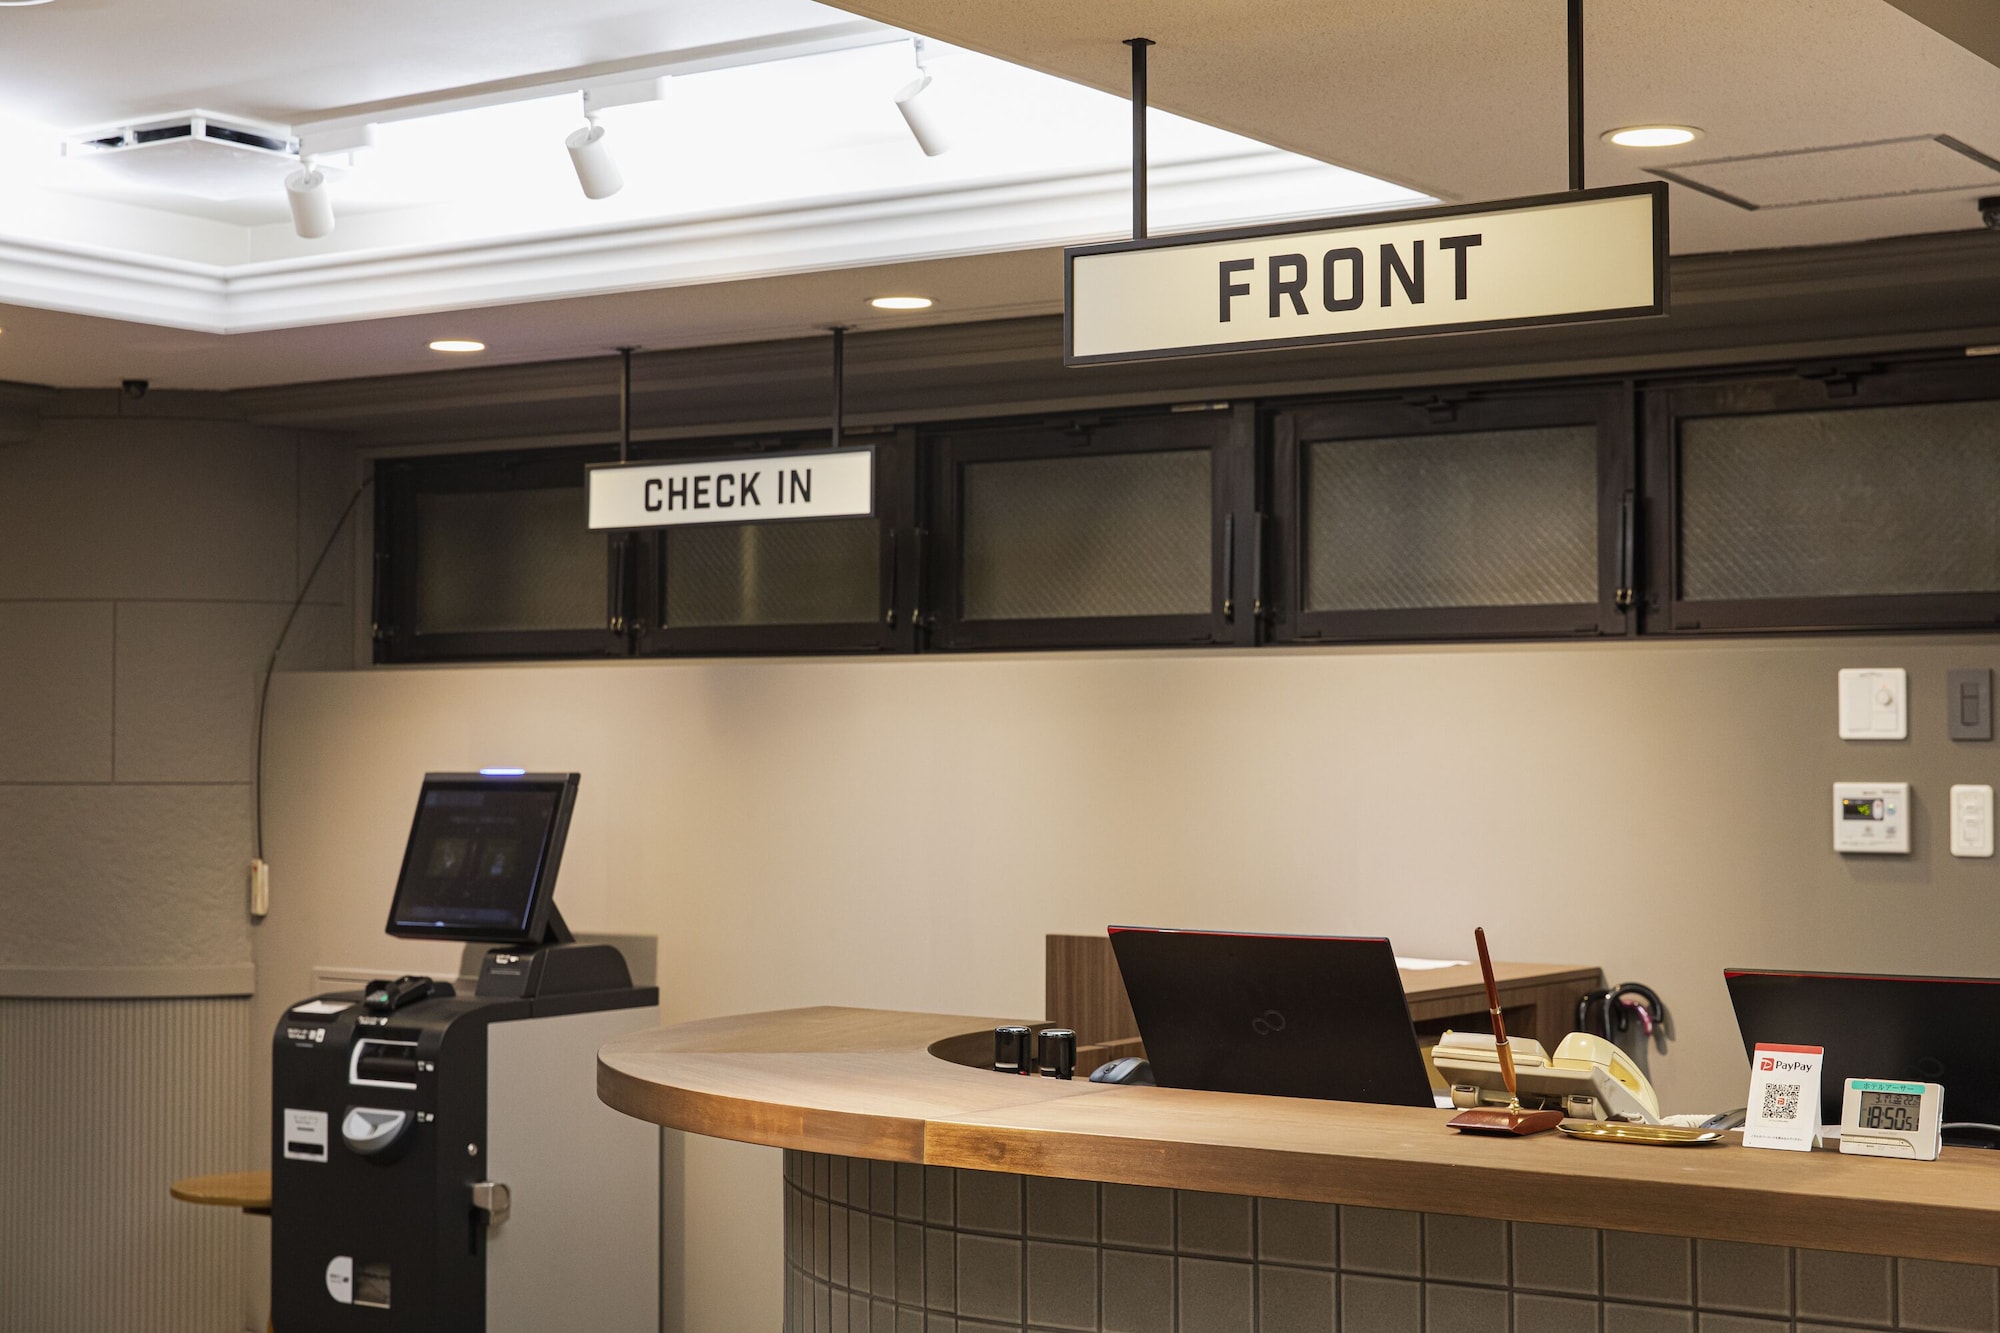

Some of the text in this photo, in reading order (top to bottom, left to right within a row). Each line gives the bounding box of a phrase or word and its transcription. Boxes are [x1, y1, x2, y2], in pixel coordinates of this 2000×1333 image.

[1219, 234, 1482, 322] FRONT
[644, 468, 812, 512] CHECK IN
[1775, 1060, 1812, 1073] PayPay
[1863, 1082, 1914, 1092] ホテルアーサー
